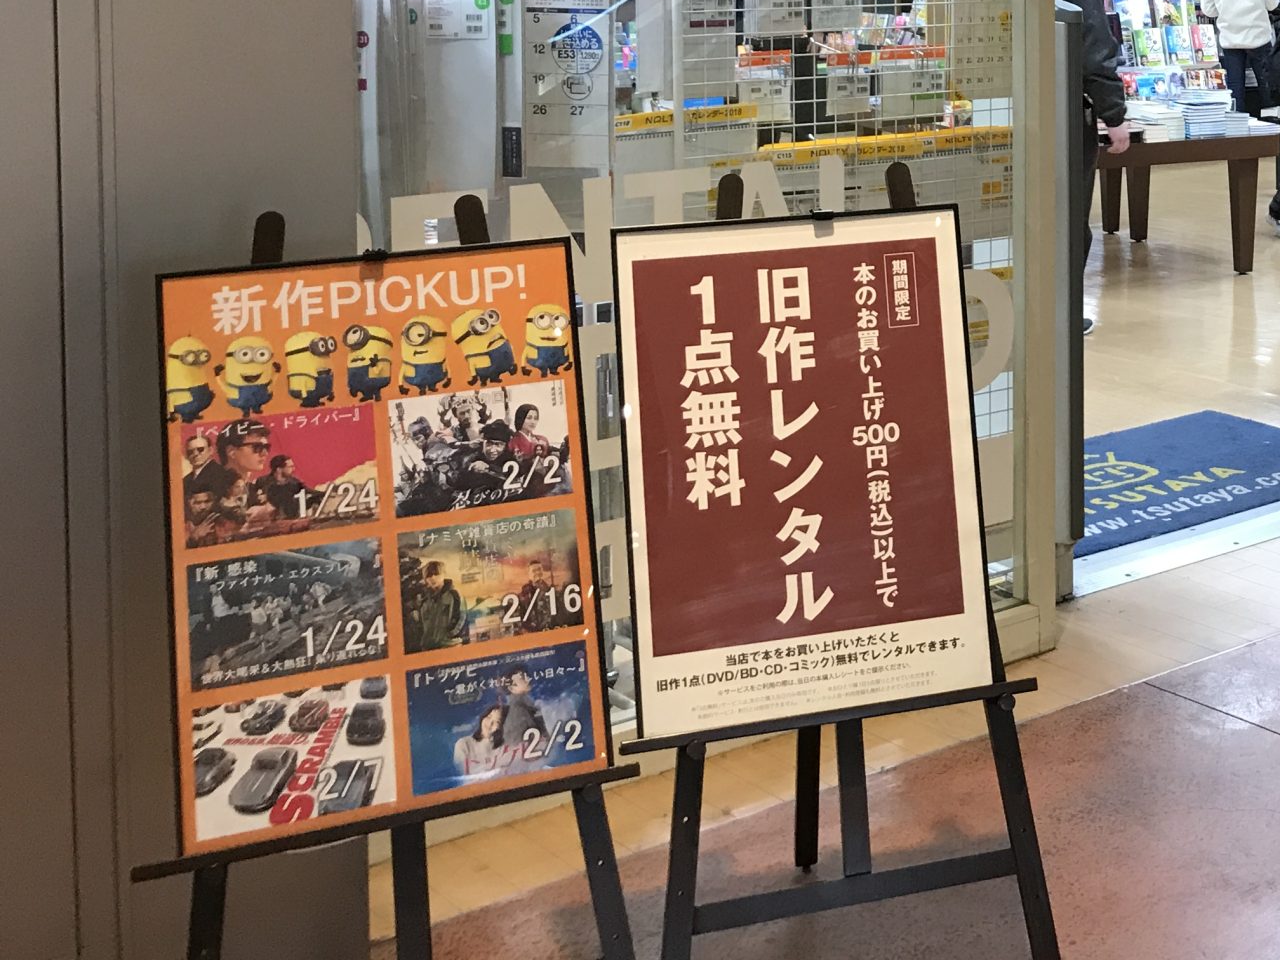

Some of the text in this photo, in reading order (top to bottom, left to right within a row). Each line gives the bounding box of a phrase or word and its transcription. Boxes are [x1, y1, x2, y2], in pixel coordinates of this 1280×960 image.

[533, 14, 541, 24] 5
[533, 44, 546, 55] 12
[557, 49, 576, 60] E53
[532, 105, 584, 116] 26 27
[645, 115, 674, 124] NOLT
[211, 264, 527, 337] 新作PICKUP!
[892, 259, 911, 320] 期間限定
[680, 275, 746, 510] 1点無料
[757, 268, 834, 623] 旧作レンタル
[502, 456, 562, 490] 2/2
[294, 480, 379, 518] 1/24
[502, 584, 582, 624] 2/16
[301, 616, 387, 657] 1/24
[726, 631, 899, 666] 当店で本をお買い上げいただくと
[523, 719, 583, 759] 2/2
[318, 758, 383, 802] 2/7
